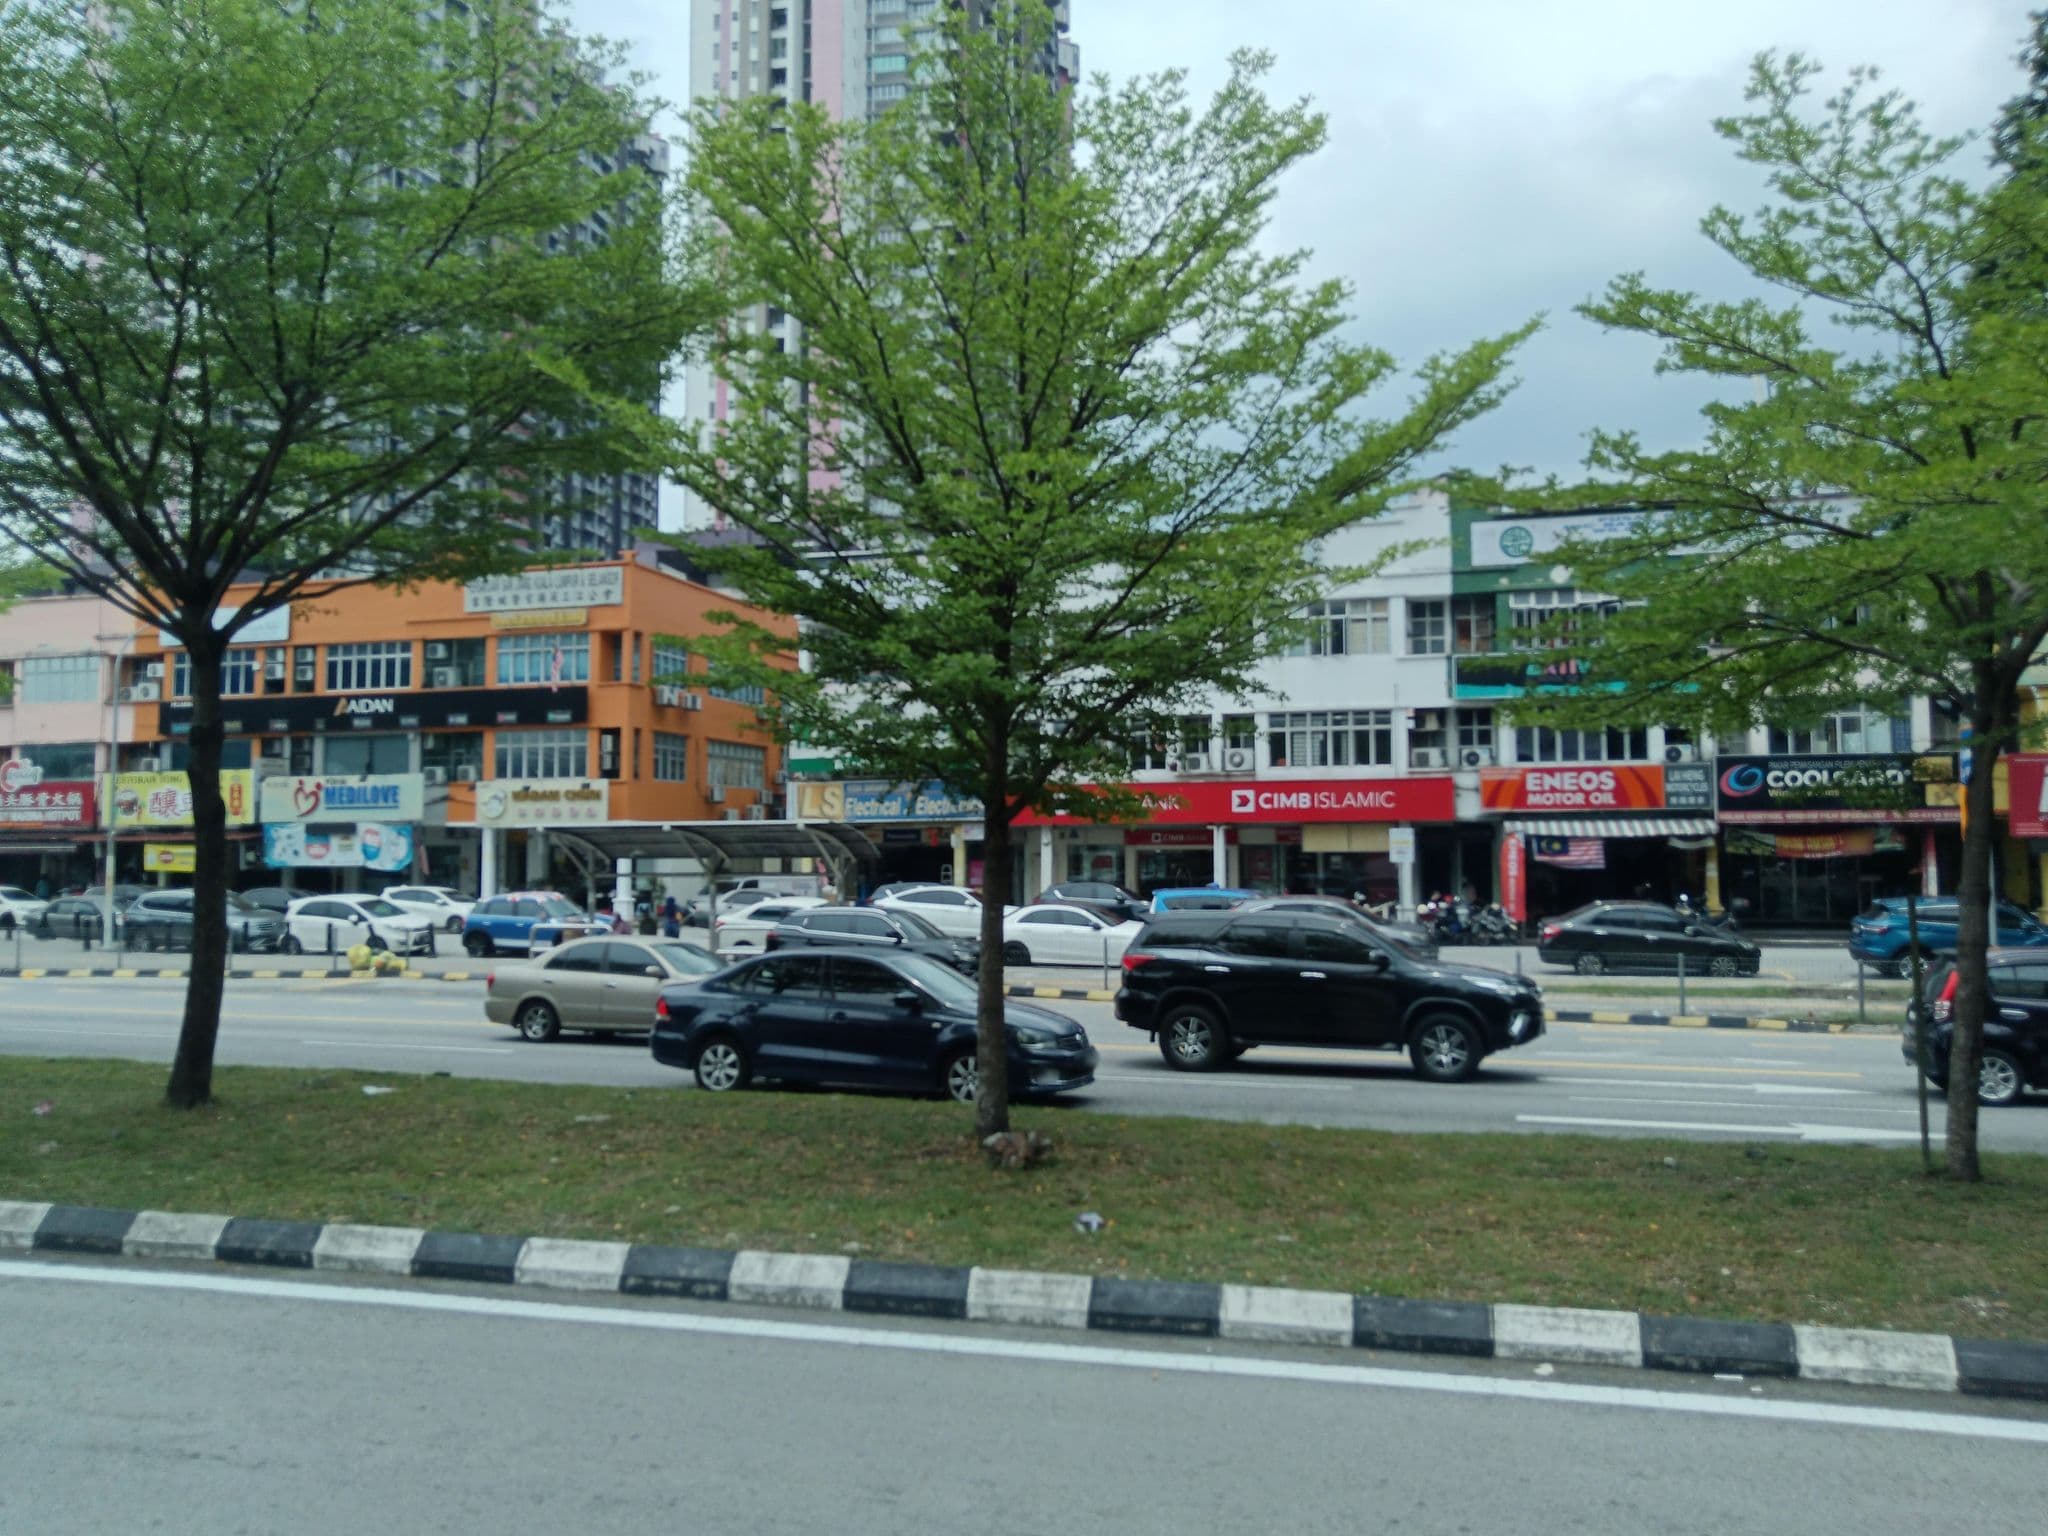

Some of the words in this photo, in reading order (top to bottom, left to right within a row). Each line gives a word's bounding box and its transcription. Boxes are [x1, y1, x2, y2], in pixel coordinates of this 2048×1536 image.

[1525, 770, 1616, 791] ENEOS
[325, 785, 400, 805] MEDILOVE
[802, 786, 840, 817] LS
[1258, 792, 1312, 809] CIMB
[1313, 790, 1396, 808] ISLAMIC
[1526, 792, 1586, 806] MOTOR
[1588, 791, 1617, 805] OIL
